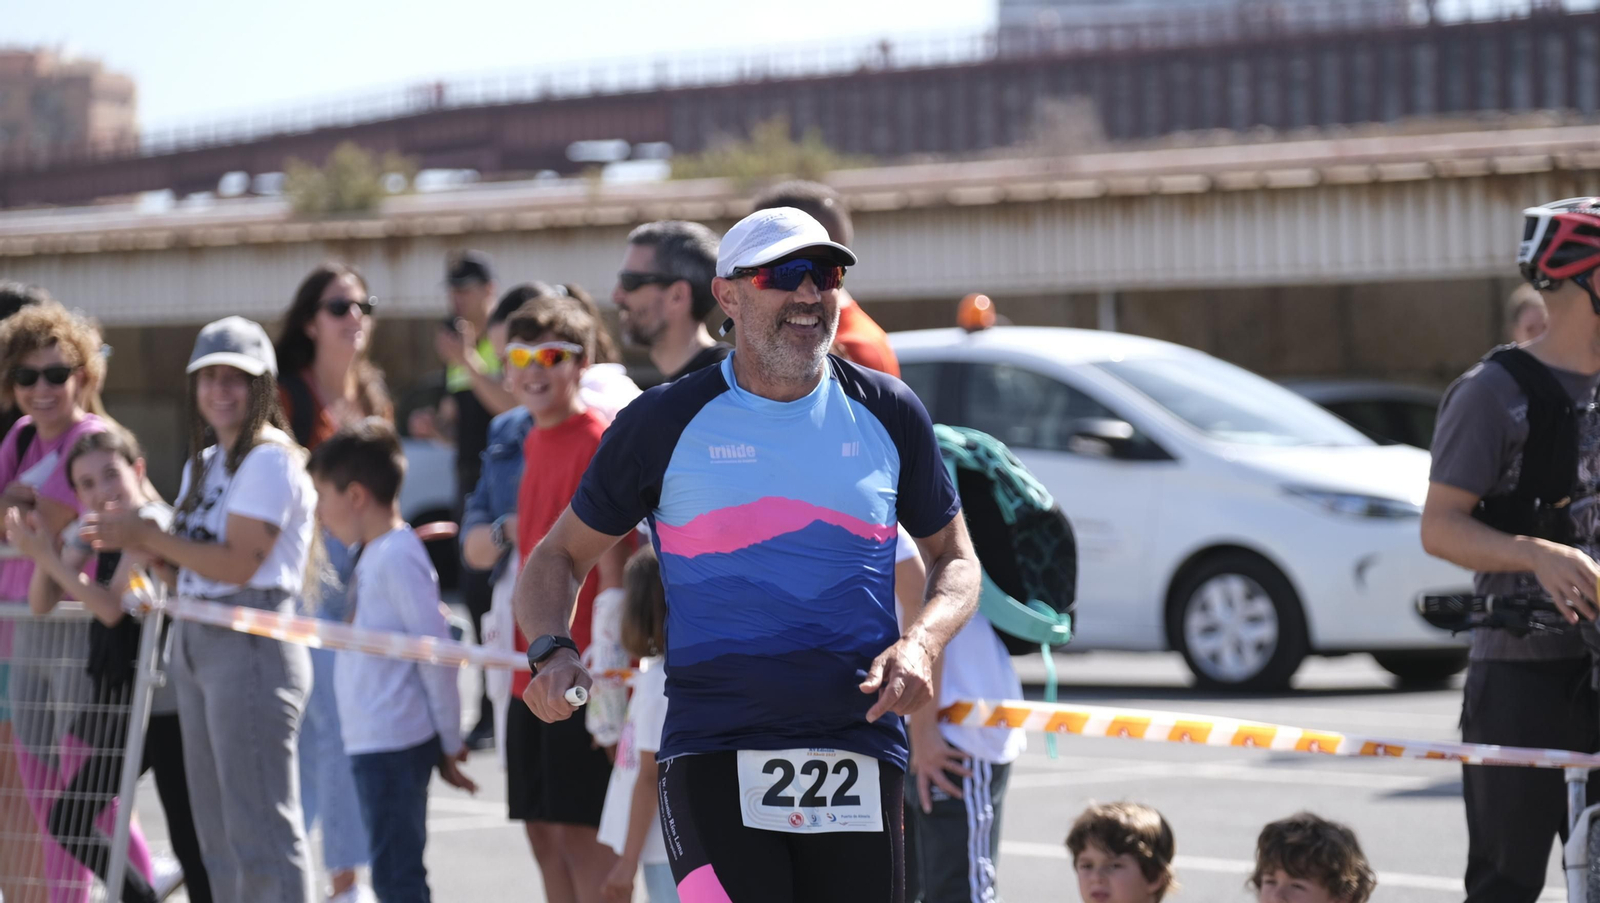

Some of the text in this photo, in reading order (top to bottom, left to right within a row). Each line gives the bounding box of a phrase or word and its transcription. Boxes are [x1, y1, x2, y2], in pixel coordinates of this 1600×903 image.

[762, 758, 861, 807] 222
[663, 790, 672, 819] Antonio
[668, 818, 677, 837] Ríos
[674, 835, 684, 857] Luna
